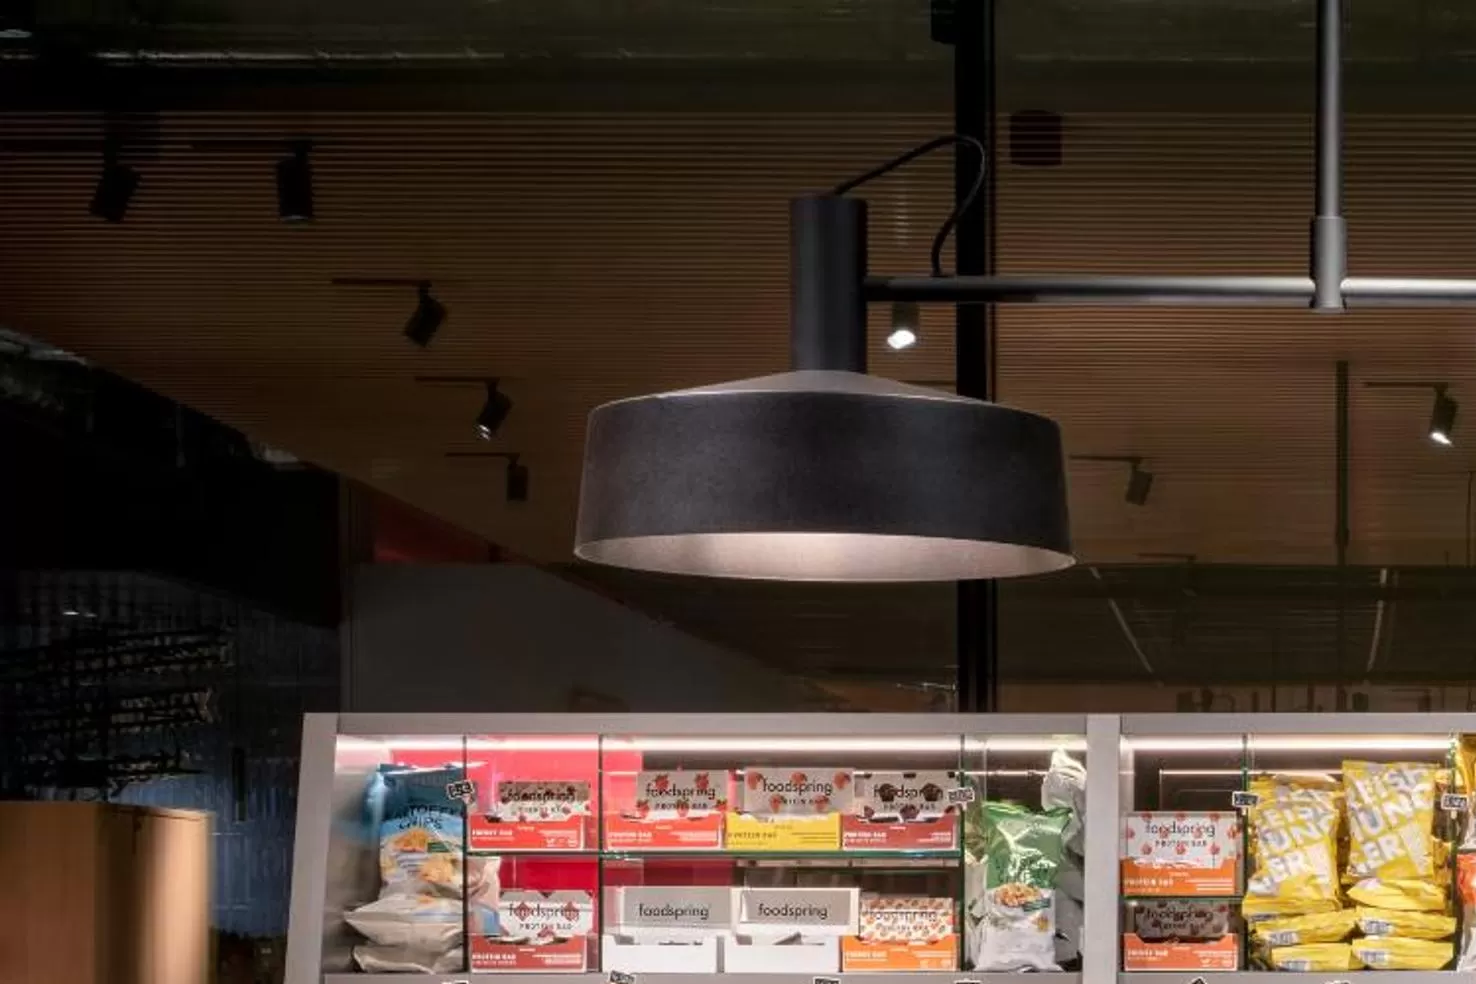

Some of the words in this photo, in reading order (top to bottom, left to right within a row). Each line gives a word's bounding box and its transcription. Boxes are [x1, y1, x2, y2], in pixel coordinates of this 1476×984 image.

[646, 783, 716, 800] foodspring
[763, 779, 833, 796] foodspring
[873, 784, 944, 800] fdsprg
[1145, 820, 1216, 839] foodspring
[508, 902, 581, 921] foodspring
[639, 903, 710, 920] foodspring
[758, 903, 829, 920] foodspring
